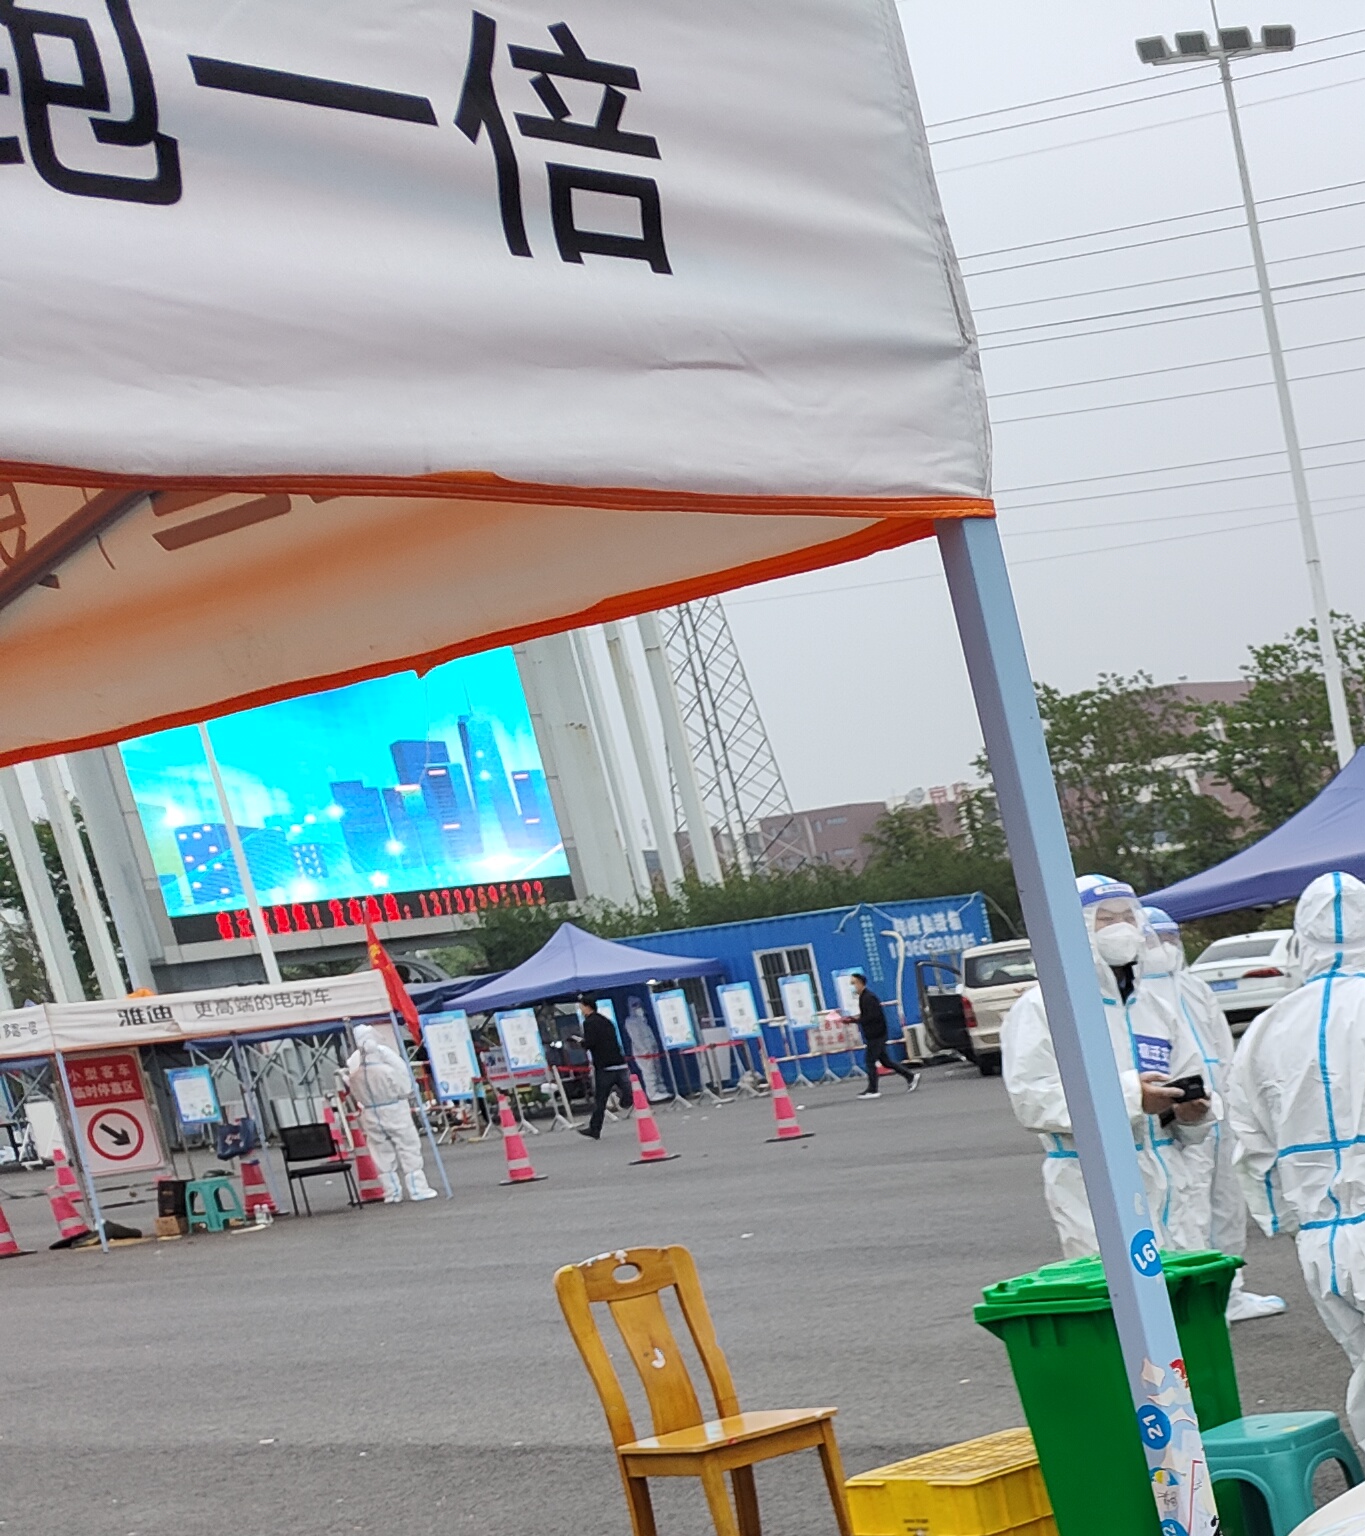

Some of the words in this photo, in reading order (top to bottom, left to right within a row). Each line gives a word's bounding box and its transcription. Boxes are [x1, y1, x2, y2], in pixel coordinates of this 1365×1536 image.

[117, 1004, 174, 1028] 雅迪
[194, 988, 332, 1020] 更高端的电动车
